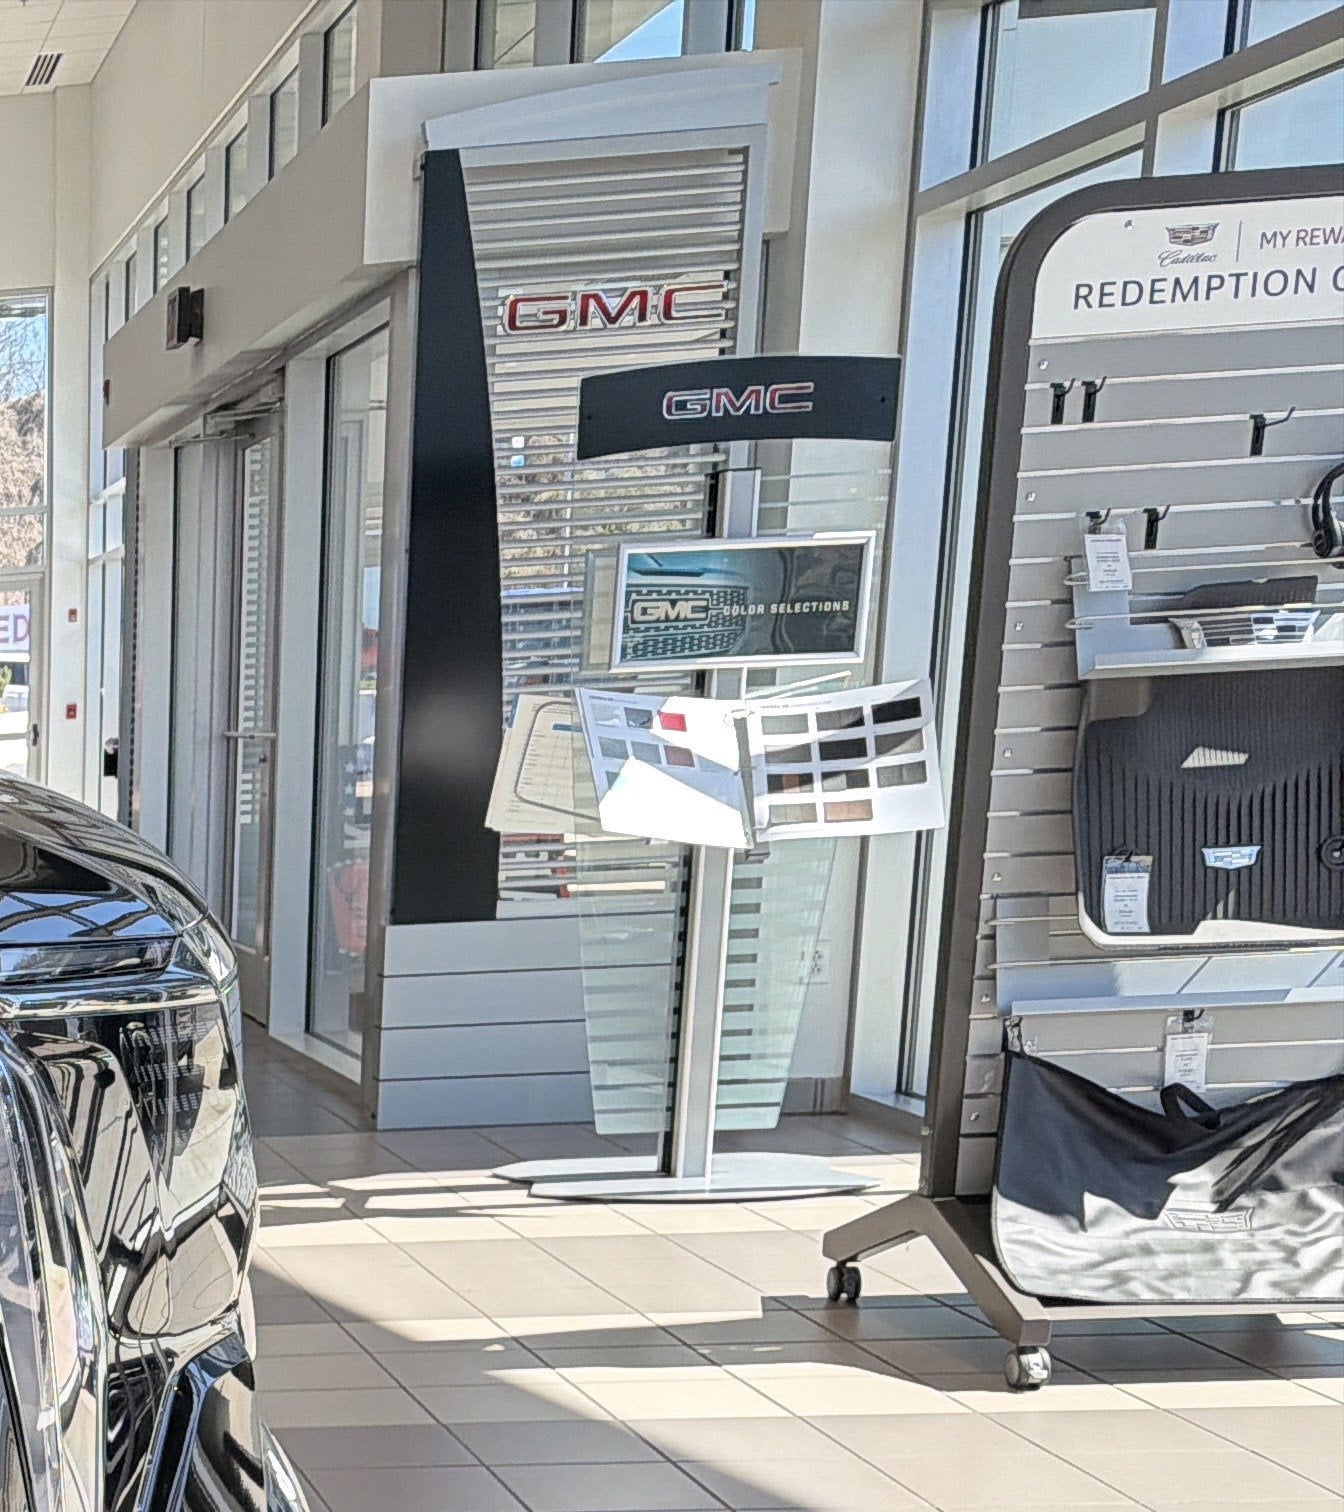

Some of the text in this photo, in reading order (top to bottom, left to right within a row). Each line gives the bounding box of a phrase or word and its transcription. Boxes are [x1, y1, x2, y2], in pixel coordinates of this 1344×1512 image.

[1260, 229, 1292, 249] MY
[1157, 249, 1218, 268] Cadillac
[1072, 266, 1318, 311] REDEMPTION
[503, 279, 732, 335] GMC
[662, 381, 815, 420] GMC
[633, 599, 709, 622] GMC
[769, 600, 851, 615] SELECTIONS
